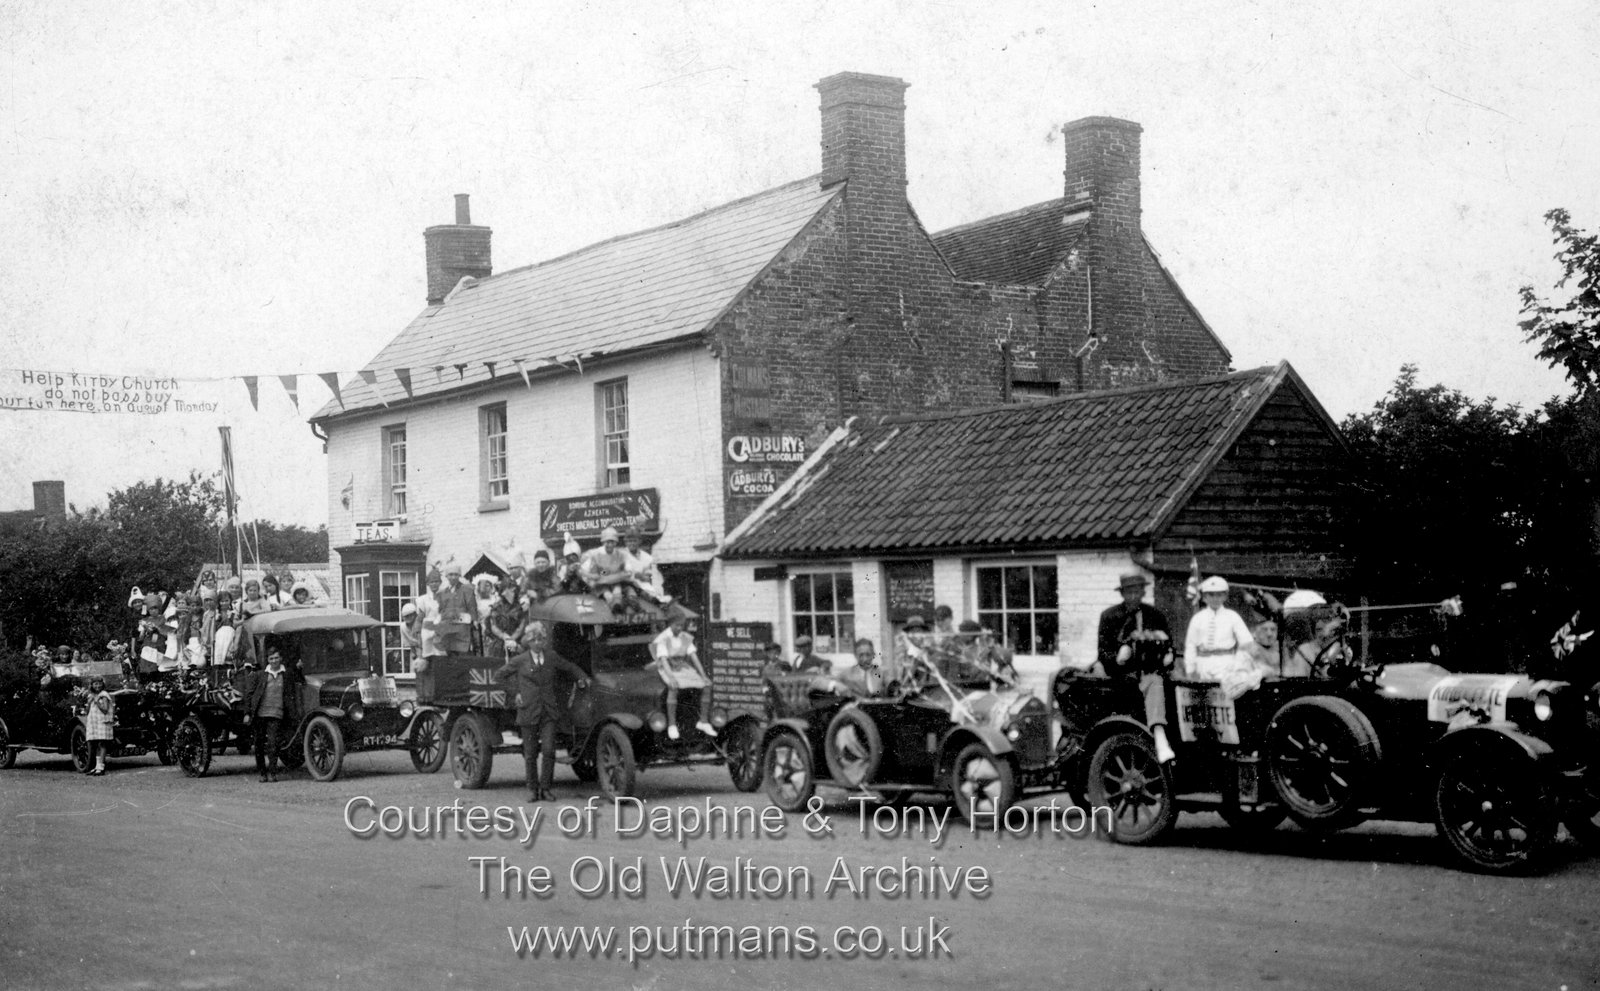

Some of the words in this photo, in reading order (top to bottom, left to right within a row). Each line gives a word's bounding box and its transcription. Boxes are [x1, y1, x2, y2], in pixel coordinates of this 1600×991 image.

[22, 370, 64, 389] Help
[122, 375, 179, 390] Church
[44, 387, 64, 399] do
[71, 388, 97, 401] not
[103, 402, 121, 412] on
[766, 452, 805, 462] CHOCOLATE
[743, 484, 775, 493] COCOA
[556, 521, 575, 533] SWEETS
[575, 518, 600, 531] MINERALS
[735, 627, 751, 638] SELL
